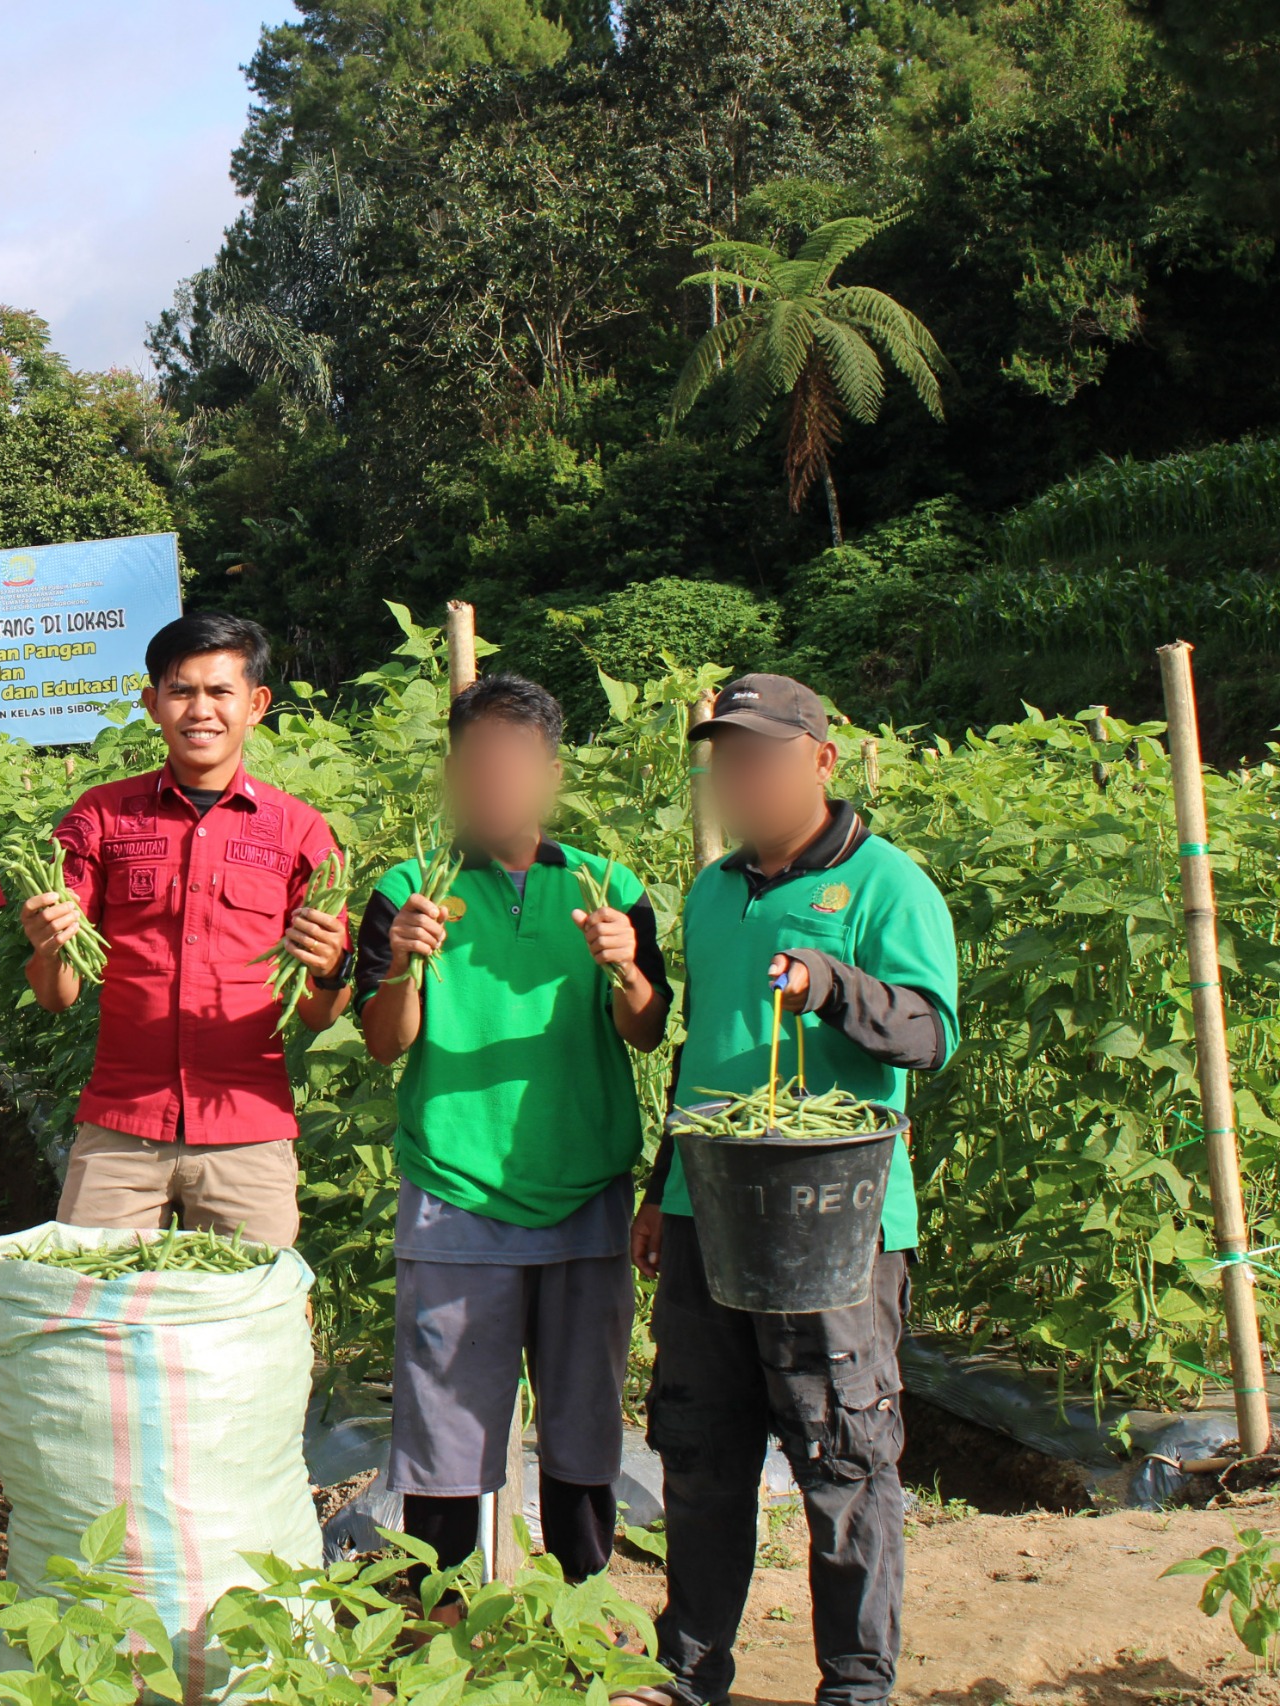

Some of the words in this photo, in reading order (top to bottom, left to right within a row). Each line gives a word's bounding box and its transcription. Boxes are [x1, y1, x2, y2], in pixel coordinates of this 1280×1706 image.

[40, 614, 62, 634] DI
[67, 608, 125, 632] LOKASI
[23, 641, 96, 661] Pangan
[1, 684, 38, 701] dan
[42, 676, 118, 698] Edukasi
[10, 707, 46, 719] KELAS
[49, 706, 63, 716] IIB
